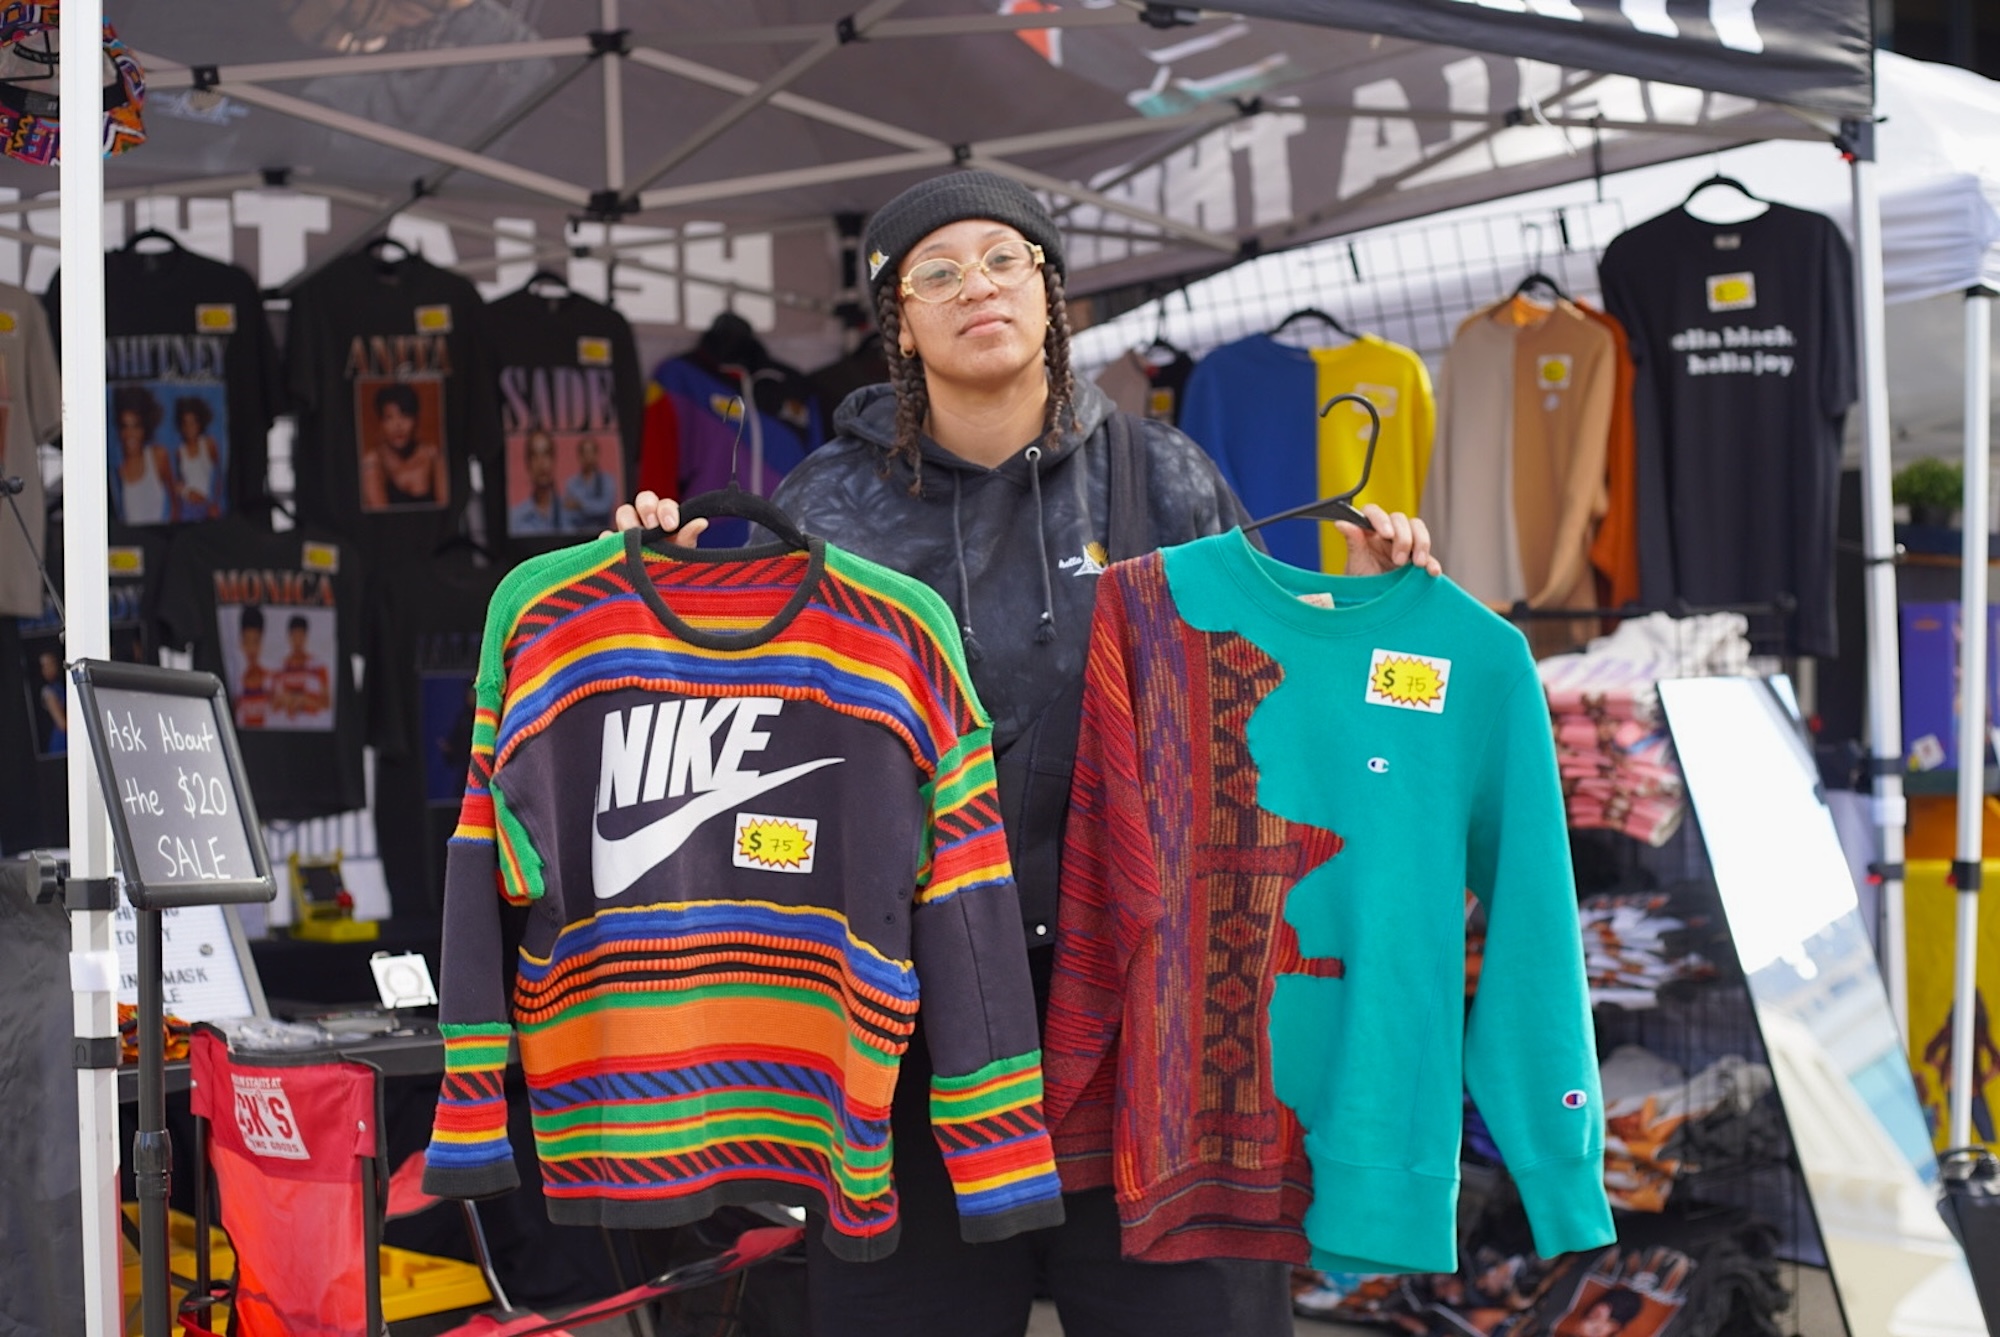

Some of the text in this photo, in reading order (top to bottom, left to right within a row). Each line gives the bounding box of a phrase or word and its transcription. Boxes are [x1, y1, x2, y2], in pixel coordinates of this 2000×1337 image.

[500, 366, 622, 434] SADE
[213, 568, 337, 606] MONICA
[1382, 668, 1427, 693] $ 75
[107, 709, 214, 754] Ask About
[597, 697, 784, 815] NIKE
[125, 766, 228, 819] the $20
[158, 834, 231, 880] SALE
[749, 829, 794, 853] $ 75
